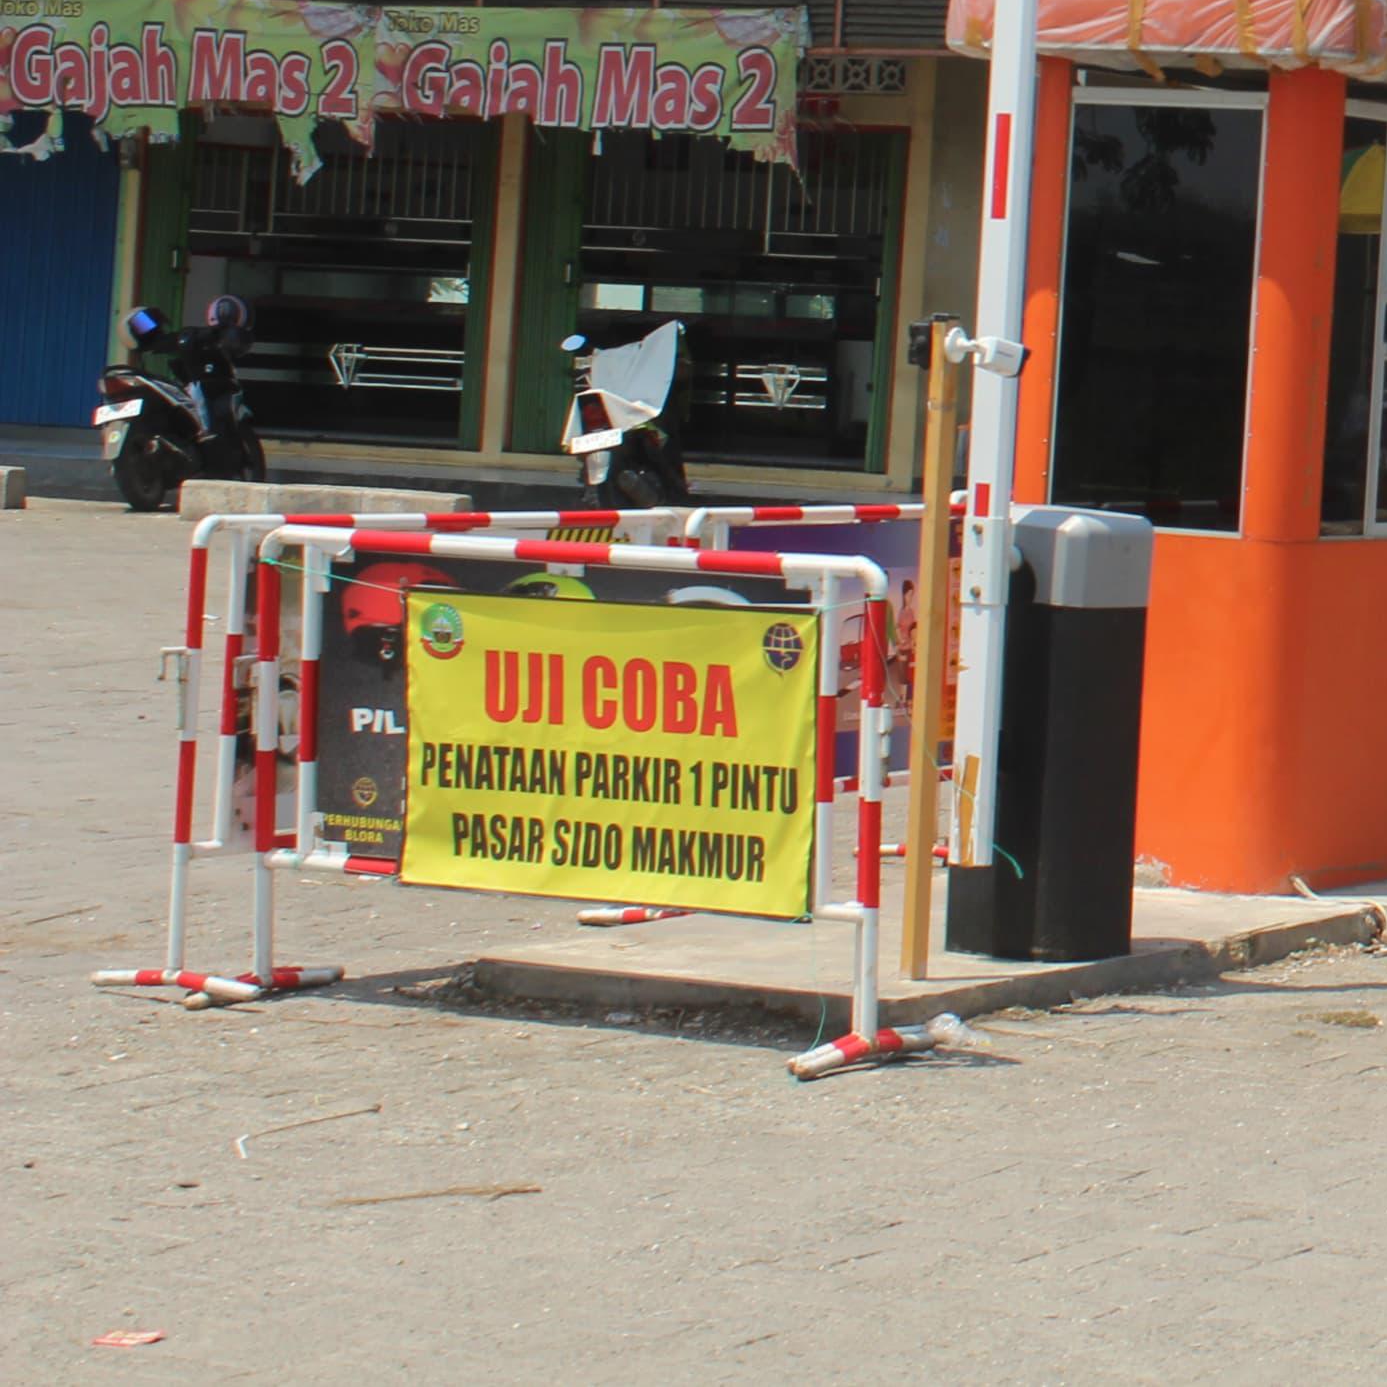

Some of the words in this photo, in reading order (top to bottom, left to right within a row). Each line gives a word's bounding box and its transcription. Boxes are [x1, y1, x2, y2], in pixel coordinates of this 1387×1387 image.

[439, 12, 480, 35] Mas
[10, 21, 178, 124] Gajah
[188, 27, 311, 117] Mas
[317, 37, 360, 119] 2
[591, 43, 726, 131] Mas
[730, 45, 779, 132] 2
[484, 649, 565, 726] UJI
[581, 656, 738, 738] COBA
[421, 741, 567, 796] PENATAAN
[574, 750, 682, 805] PARKIR
[689, 761, 703, 807] 1
[711, 761, 798, 814] PINTU
[345, 829, 384, 843] BLORA
[452, 812, 544, 866] PASAR
[551, 819, 623, 871] SIDO
[630, 828, 766, 883] MAKMUR
